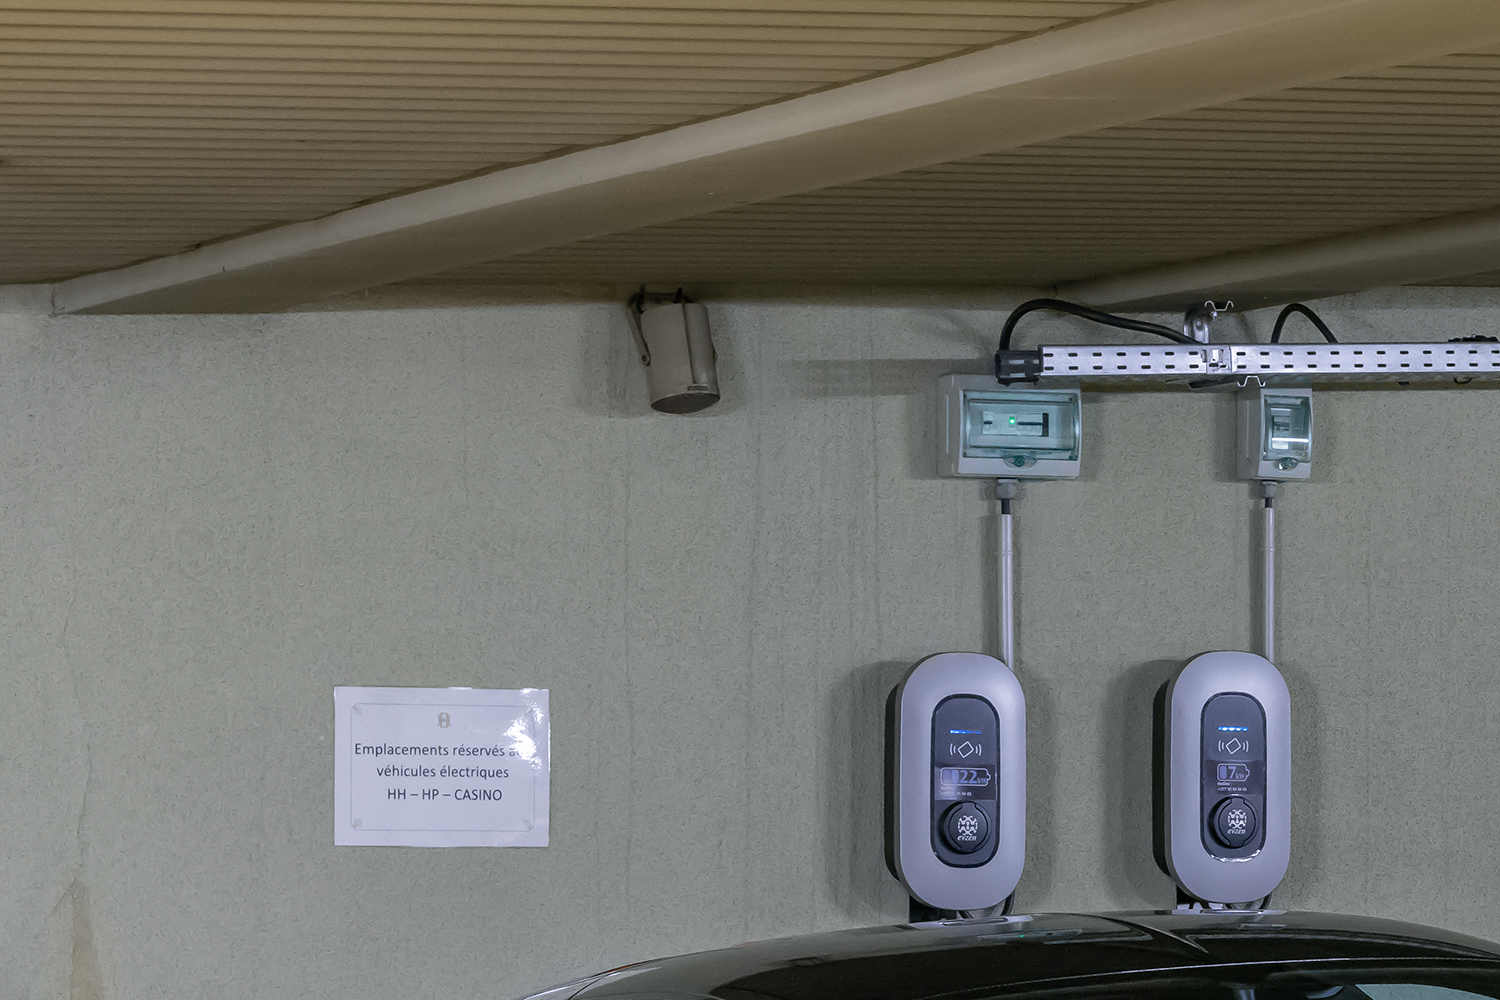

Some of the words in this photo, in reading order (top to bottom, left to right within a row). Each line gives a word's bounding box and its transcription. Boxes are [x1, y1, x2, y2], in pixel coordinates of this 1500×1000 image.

[354, 743, 449, 758] Emplacements
[452, 744, 505, 757] réservés
[376, 765, 436, 778] véhicules
[439, 765, 510, 781] électriques
[387, 788, 407, 800] HH
[422, 789, 440, 801] HP
[454, 789, 503, 801] CASINO
